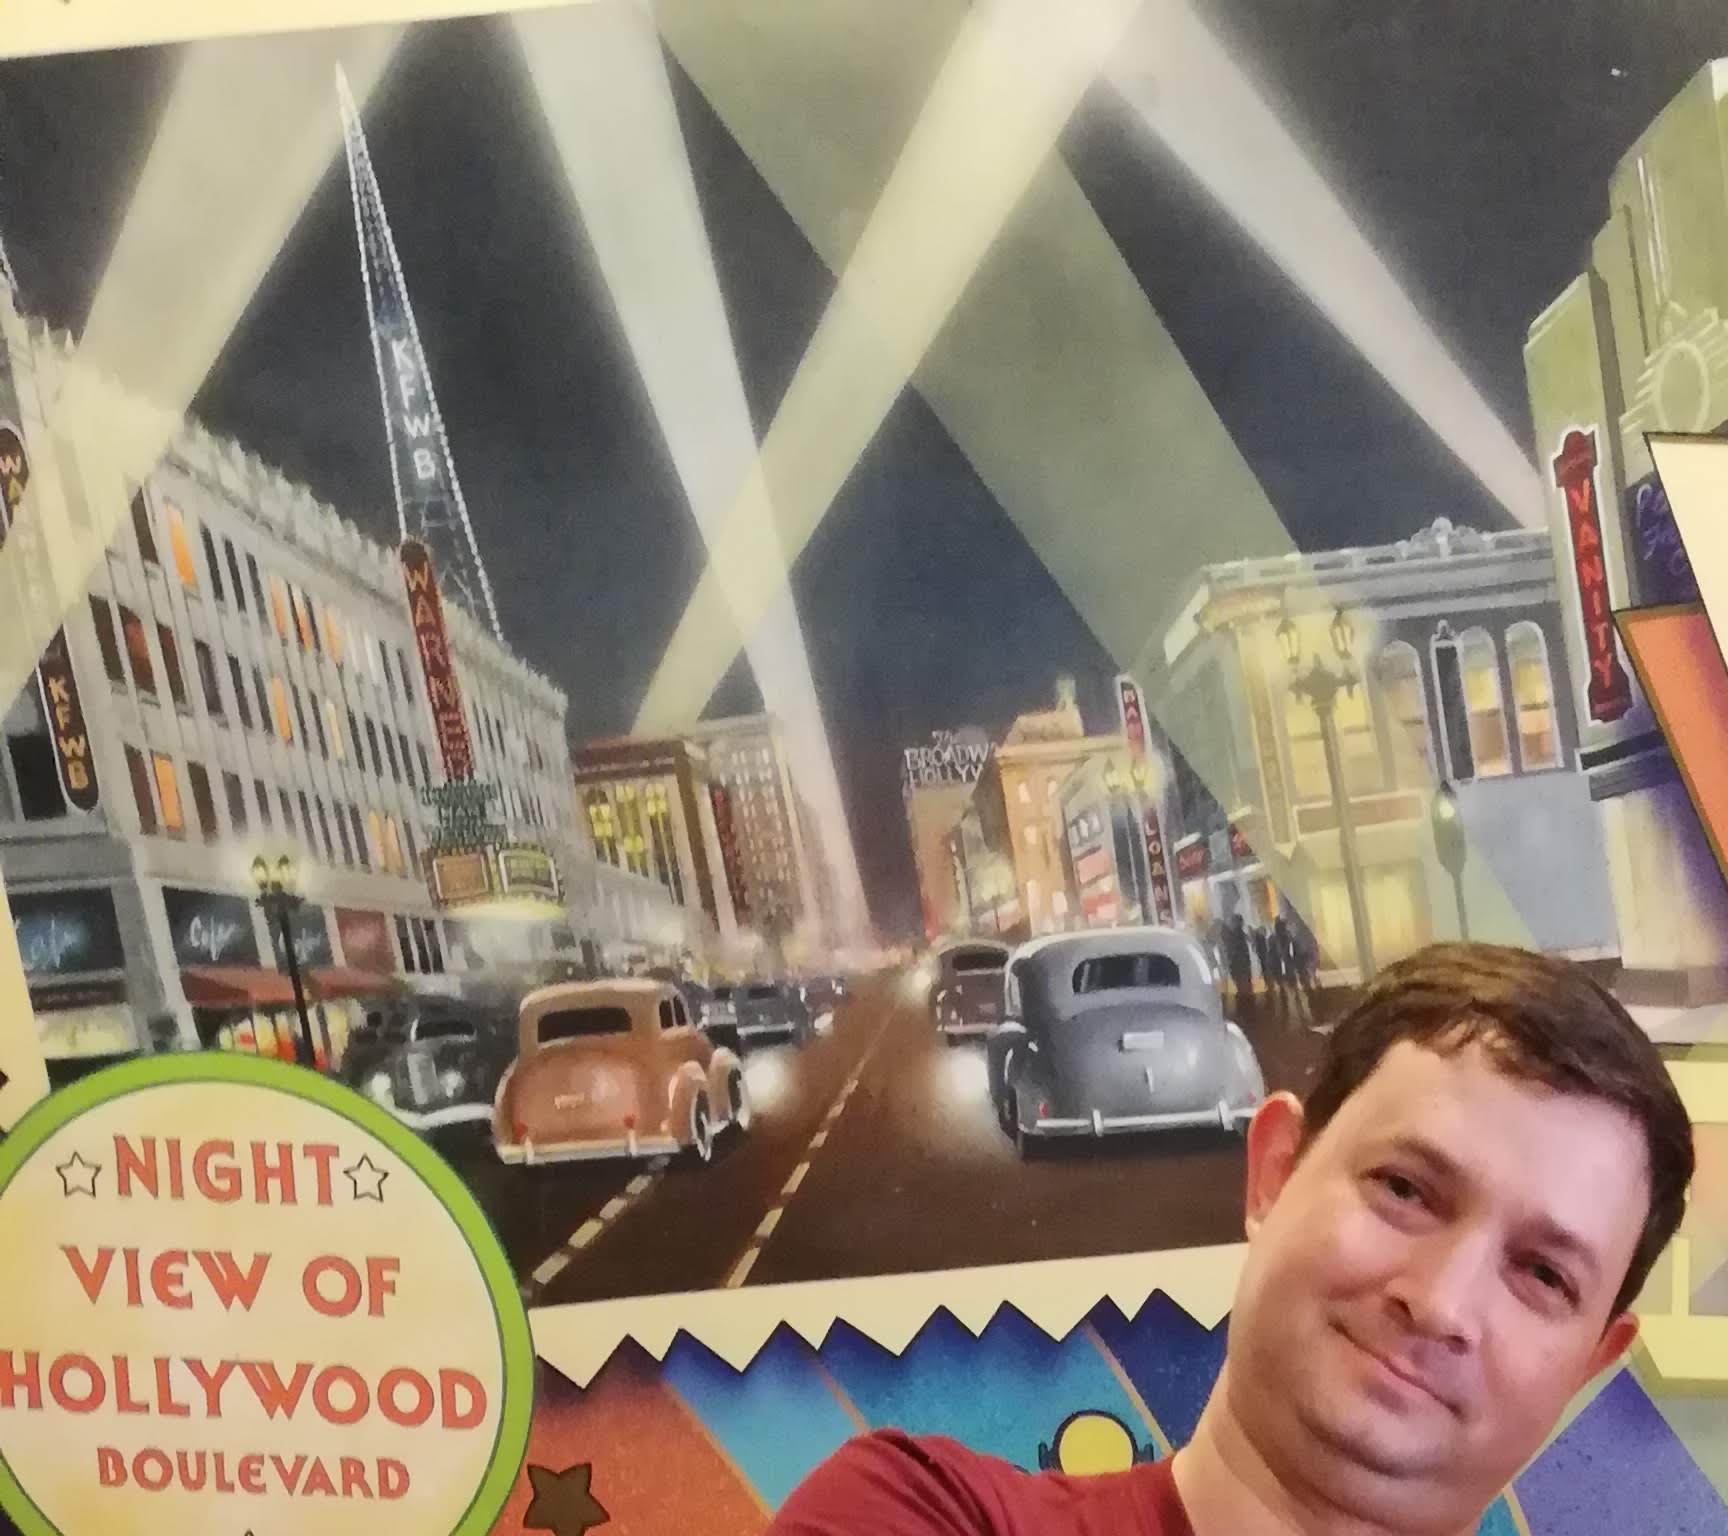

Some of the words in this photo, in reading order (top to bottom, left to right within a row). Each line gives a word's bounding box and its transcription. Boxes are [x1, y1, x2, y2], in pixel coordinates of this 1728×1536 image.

[391, 337, 436, 480] KFWB
[1568, 477, 1612, 689] VANITY
[48, 675, 90, 791] KFWB
[112, 1134, 340, 1207] NIGHT
[60, 1245, 272, 1312] VIEW
[302, 1255, 401, 1318] OF
[0, 1349, 488, 1430] HOLLYWOOD
[96, 1446, 411, 1500] BOULEVARD
